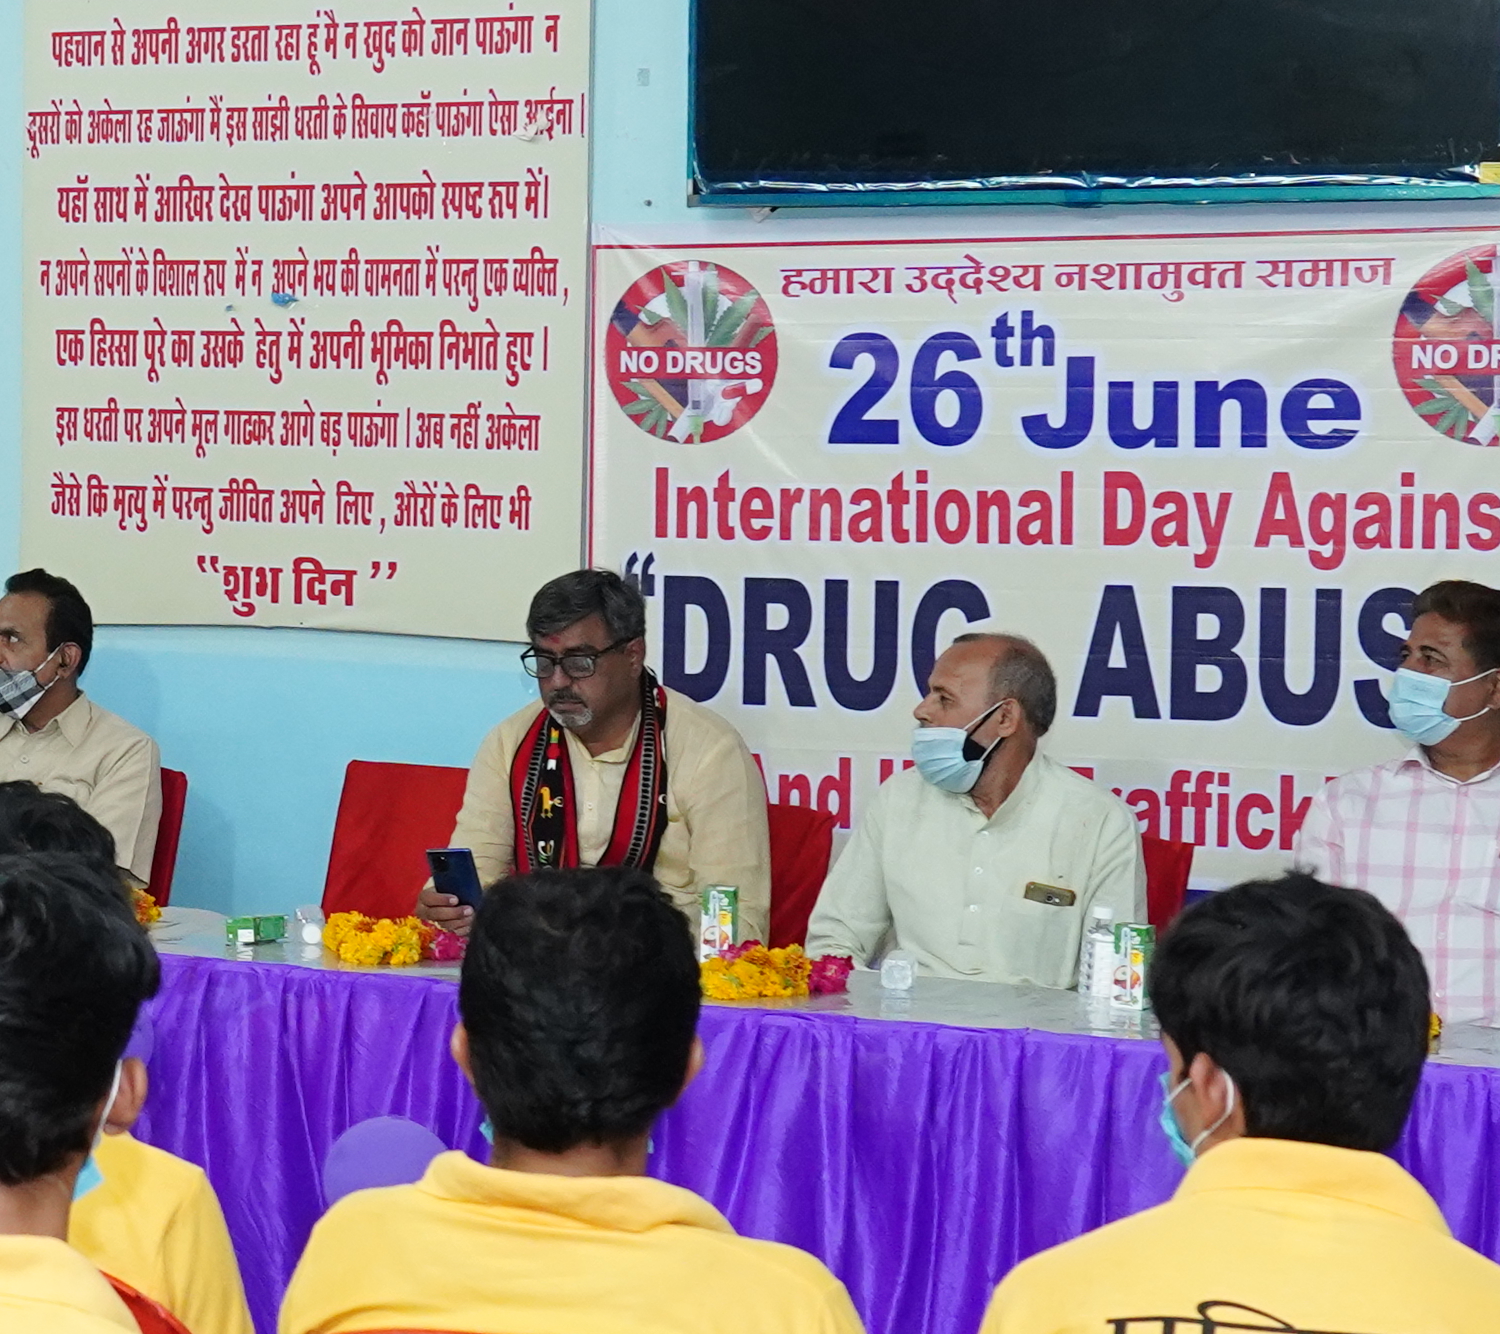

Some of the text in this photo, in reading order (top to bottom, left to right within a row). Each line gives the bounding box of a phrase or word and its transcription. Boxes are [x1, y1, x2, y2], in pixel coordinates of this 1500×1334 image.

[780, 264, 893, 298] हमारा
[1054, 258, 1243, 302] नशामुक्त
[1256, 255, 1396, 289] समाज
[55, 317, 535, 387] एक हिस्सा पूरे का उसके हेतु में अपनी भूमिका निभाते हुए
[619, 349, 763, 375] NO DRUGS
[1411, 344, 1459, 370] NO
[55, 407, 80, 446] इस
[83, 397, 119, 442] धरती
[123, 408, 144, 443] पर
[148, 397, 187, 444] अपने
[191, 409, 220, 458] मूल
[280, 399, 315, 447] आगे
[347, 399, 399, 448] पाऊंगा
[416, 413, 445, 449] अब
[450, 401, 482, 450] नहीं
[485, 402, 541, 451] अकेला
[1021, 354, 1363, 450] June
[653, 467, 1073, 549] International
[1102, 471, 1233, 568] Day
[292, 556, 357, 606] दिन
